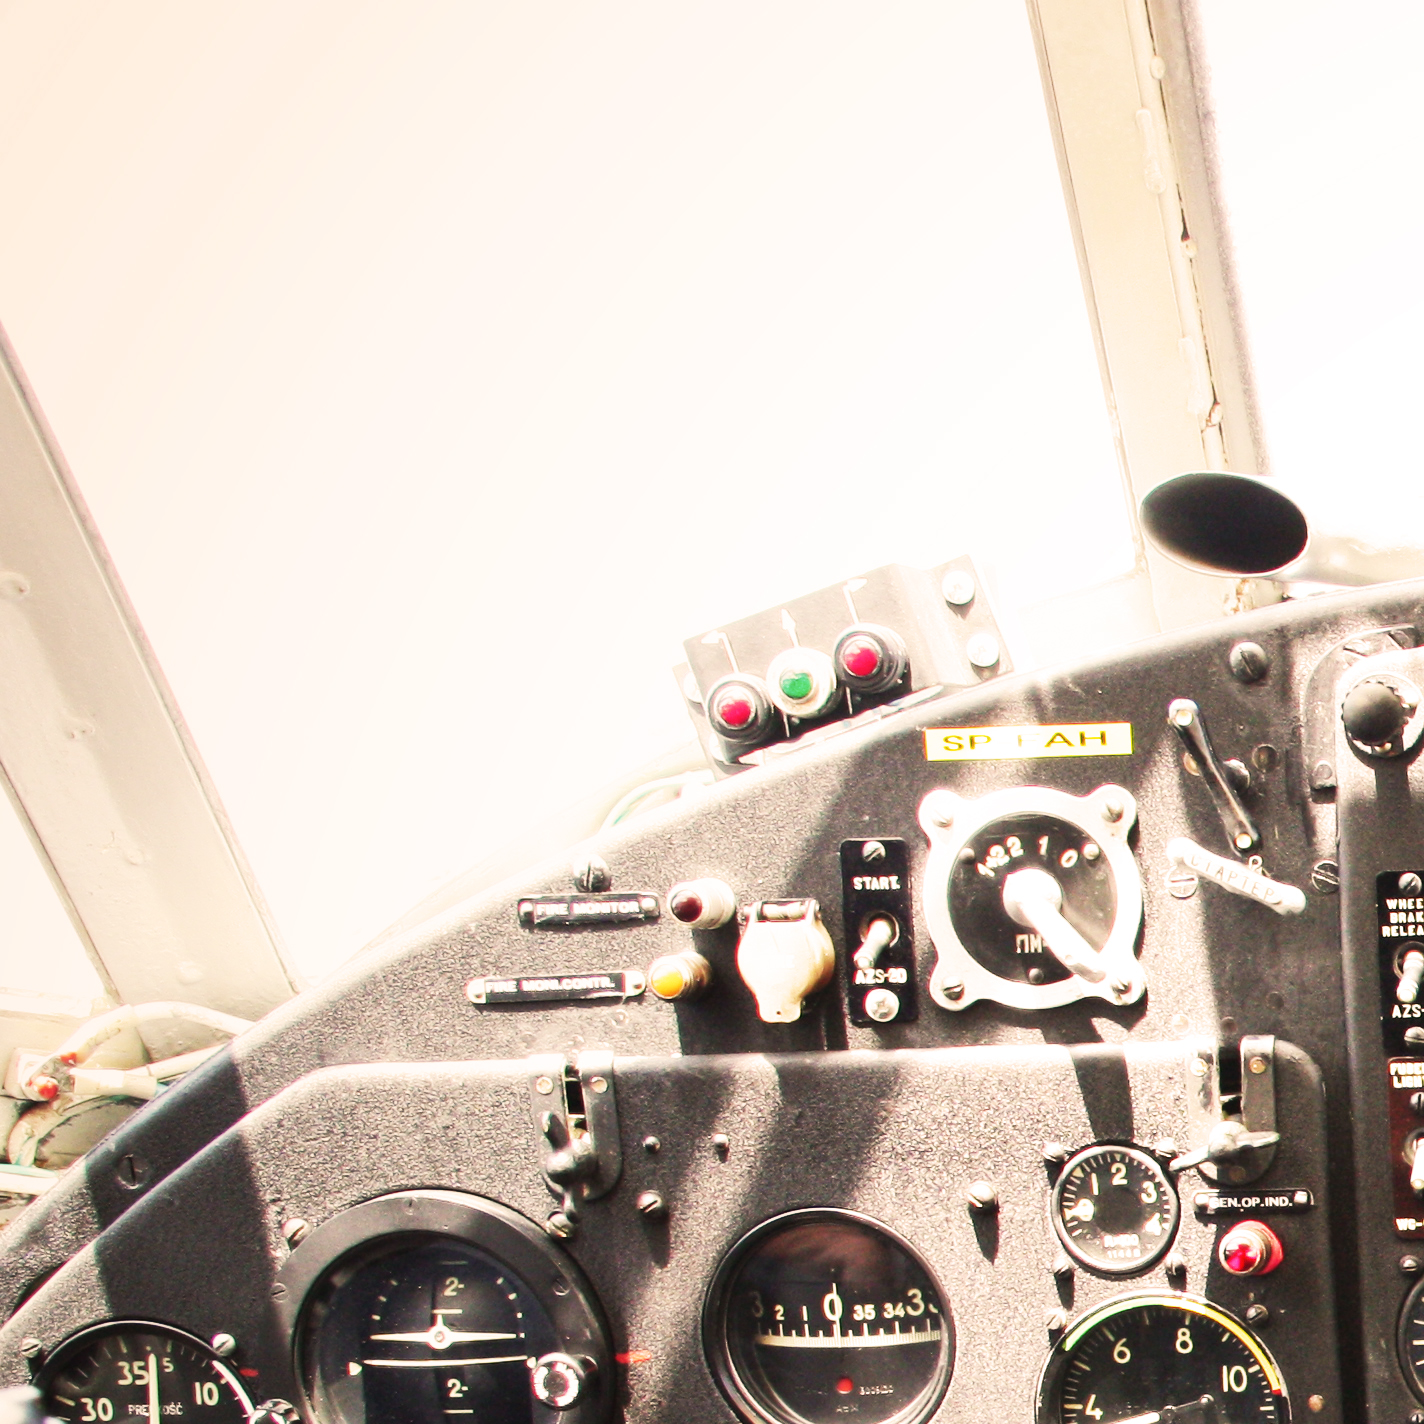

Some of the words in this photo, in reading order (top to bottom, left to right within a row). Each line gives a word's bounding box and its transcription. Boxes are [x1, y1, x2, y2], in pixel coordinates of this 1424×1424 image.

[943, 735, 991, 752] SP
[536, 903, 569, 917] FIRE
[573, 901, 640, 916] MONITOR
[853, 1304, 876, 1321] 35
[1113, 1338, 1131, 1364] 6
[1175, 1328, 1193, 1354] 8
[117, 1361, 149, 1386] 35
[1222, 1365, 1248, 1393] 10
[193, 1382, 219, 1406] 10
[80, 1398, 113, 1422] 30
